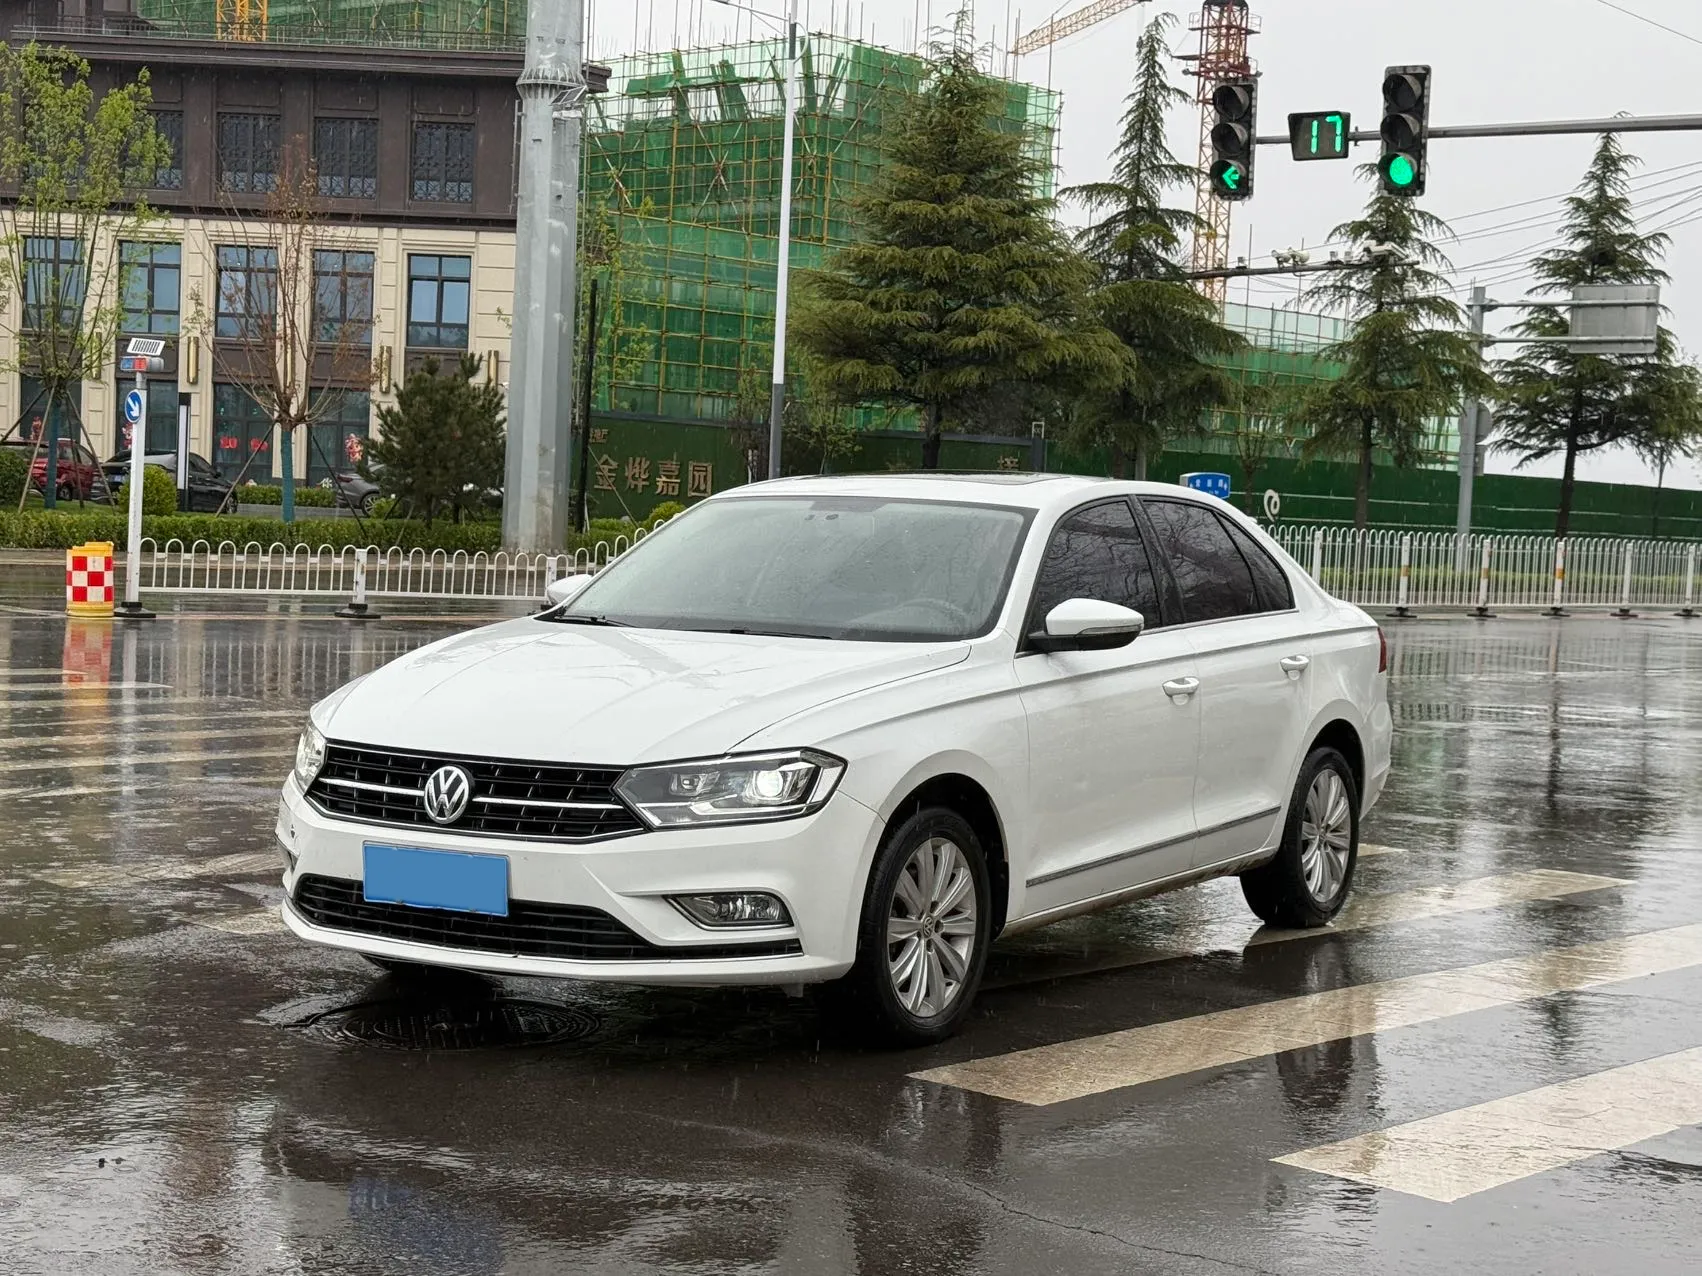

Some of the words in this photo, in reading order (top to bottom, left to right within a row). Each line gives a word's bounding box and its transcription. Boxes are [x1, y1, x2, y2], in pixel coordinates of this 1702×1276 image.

[1311, 115, 1342, 153] 17
[594, 454, 712, 497] 金烨嘉园
[425, 766, 469, 823] VW
